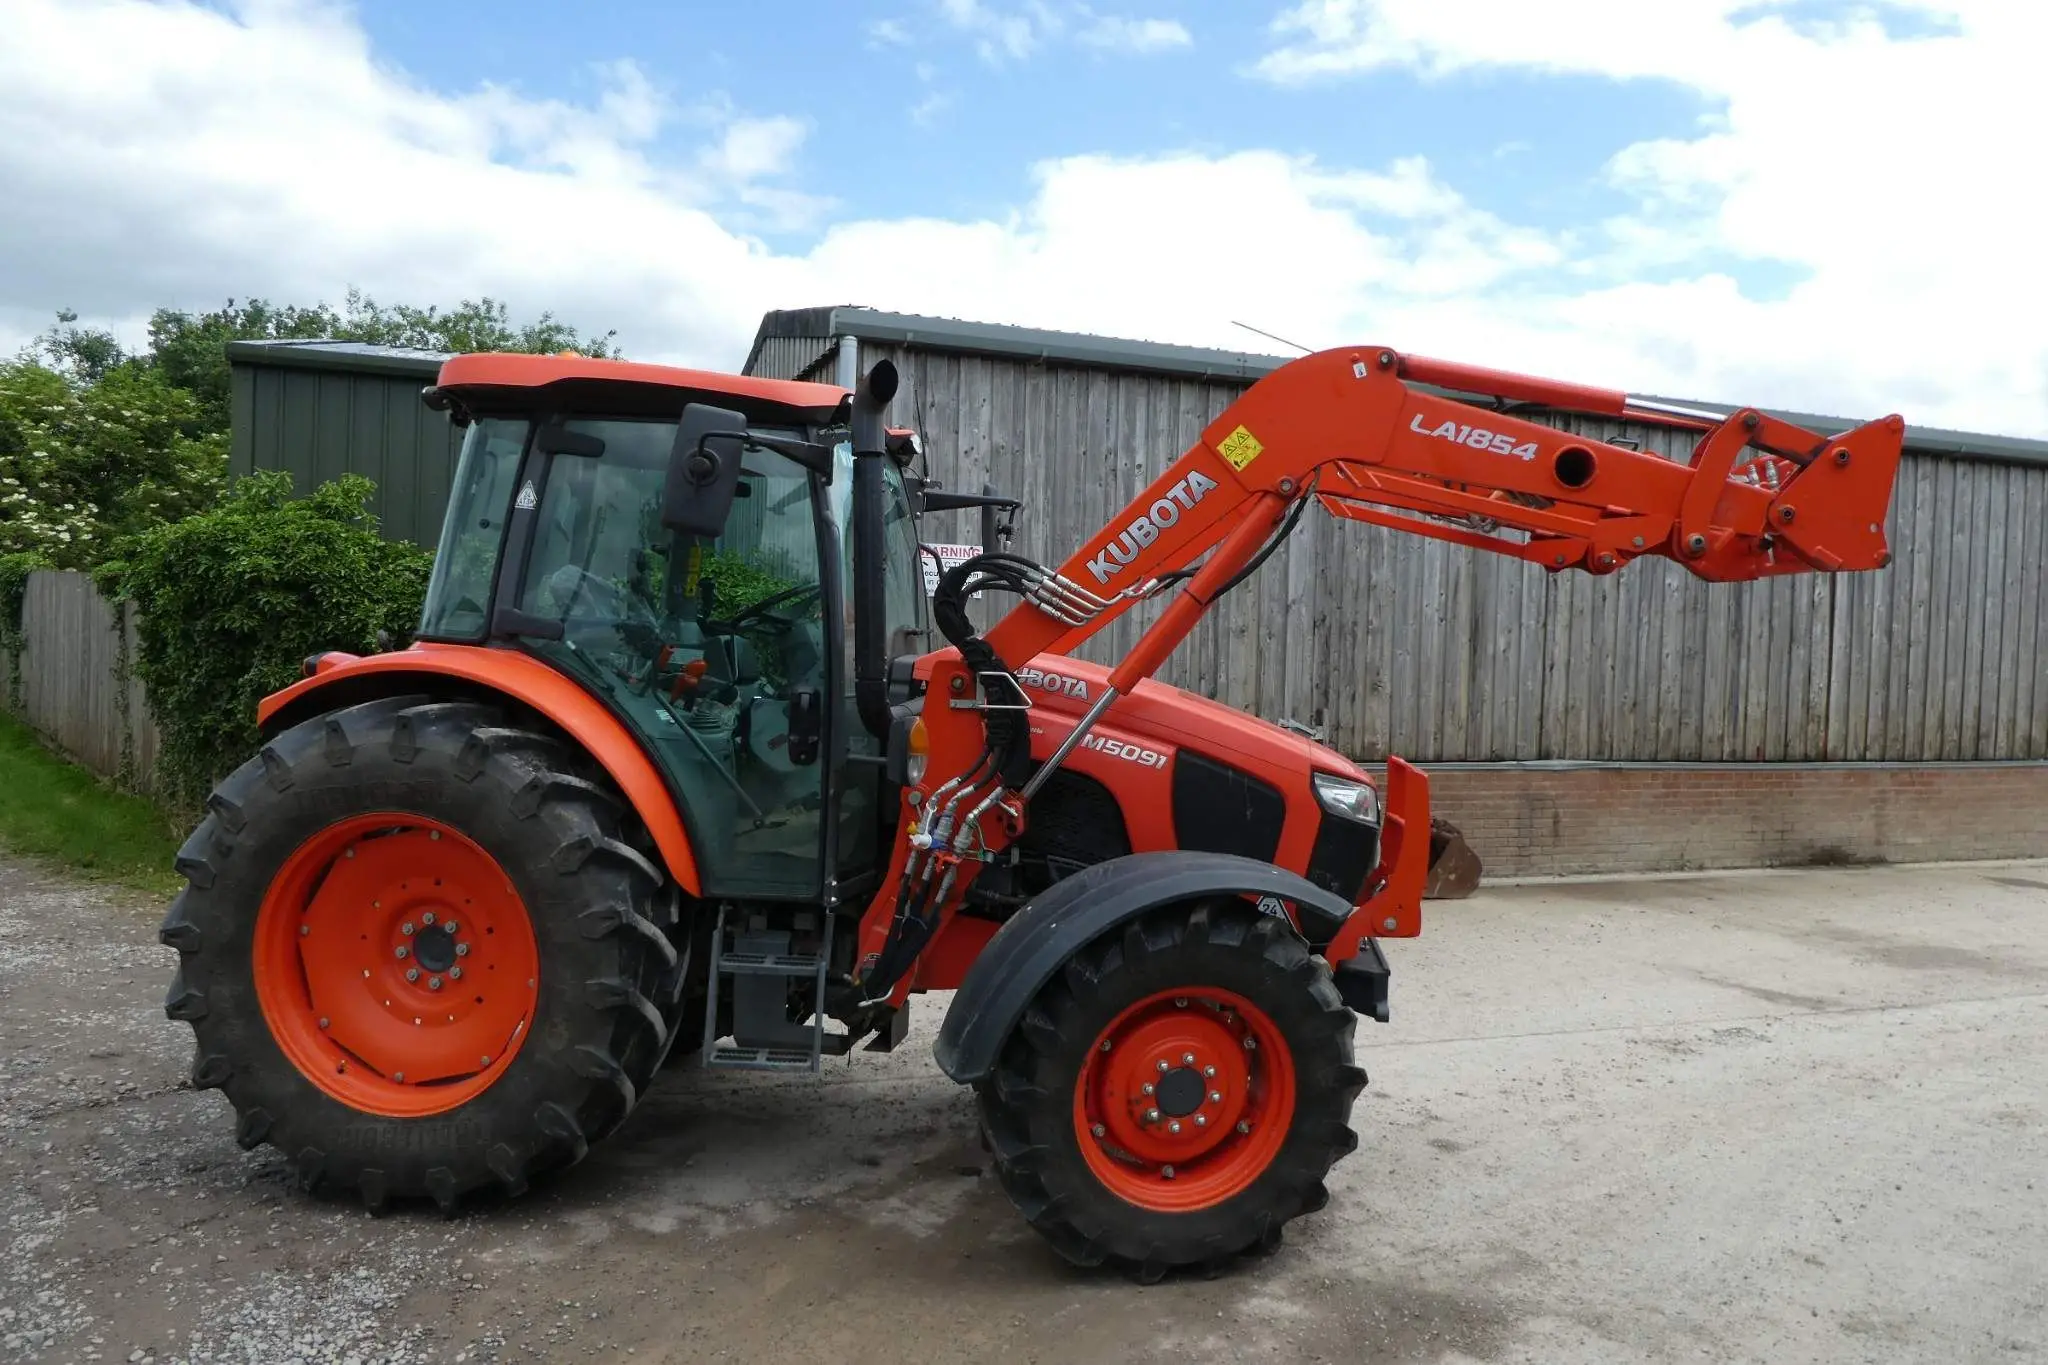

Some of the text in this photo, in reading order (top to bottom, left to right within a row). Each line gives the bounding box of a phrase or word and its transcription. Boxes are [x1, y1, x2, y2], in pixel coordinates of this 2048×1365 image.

[1409, 413, 1539, 462] LA1854
[1085, 470, 1219, 585] KUBOTA
[1014, 667, 1088, 700] UBOTA
[1080, 733, 1168, 770] M5091
[1262, 904, 1277, 915] 24
